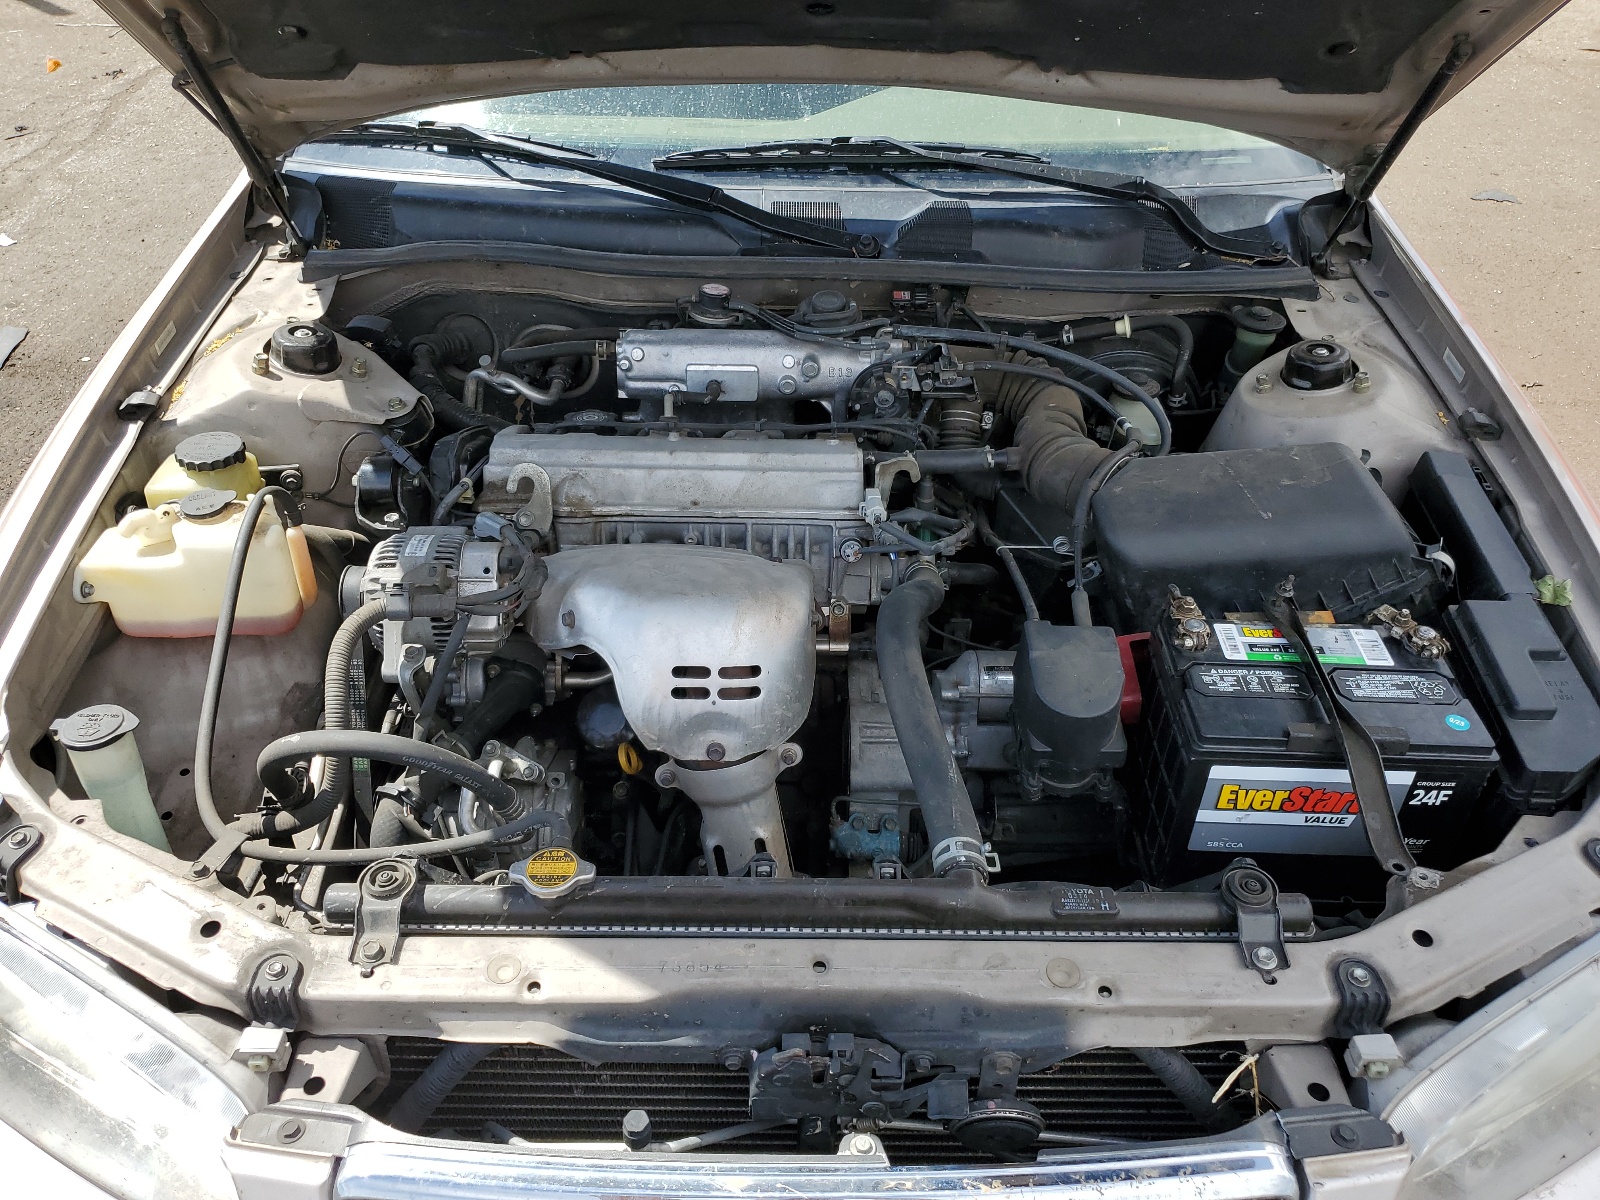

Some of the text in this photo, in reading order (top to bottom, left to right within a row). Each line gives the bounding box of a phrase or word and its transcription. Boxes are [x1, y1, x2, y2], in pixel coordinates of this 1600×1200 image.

[1242, 626, 1283, 638] EverS
[1408, 790, 1453, 806] 24F
[1304, 815, 1349, 825] VALUE
